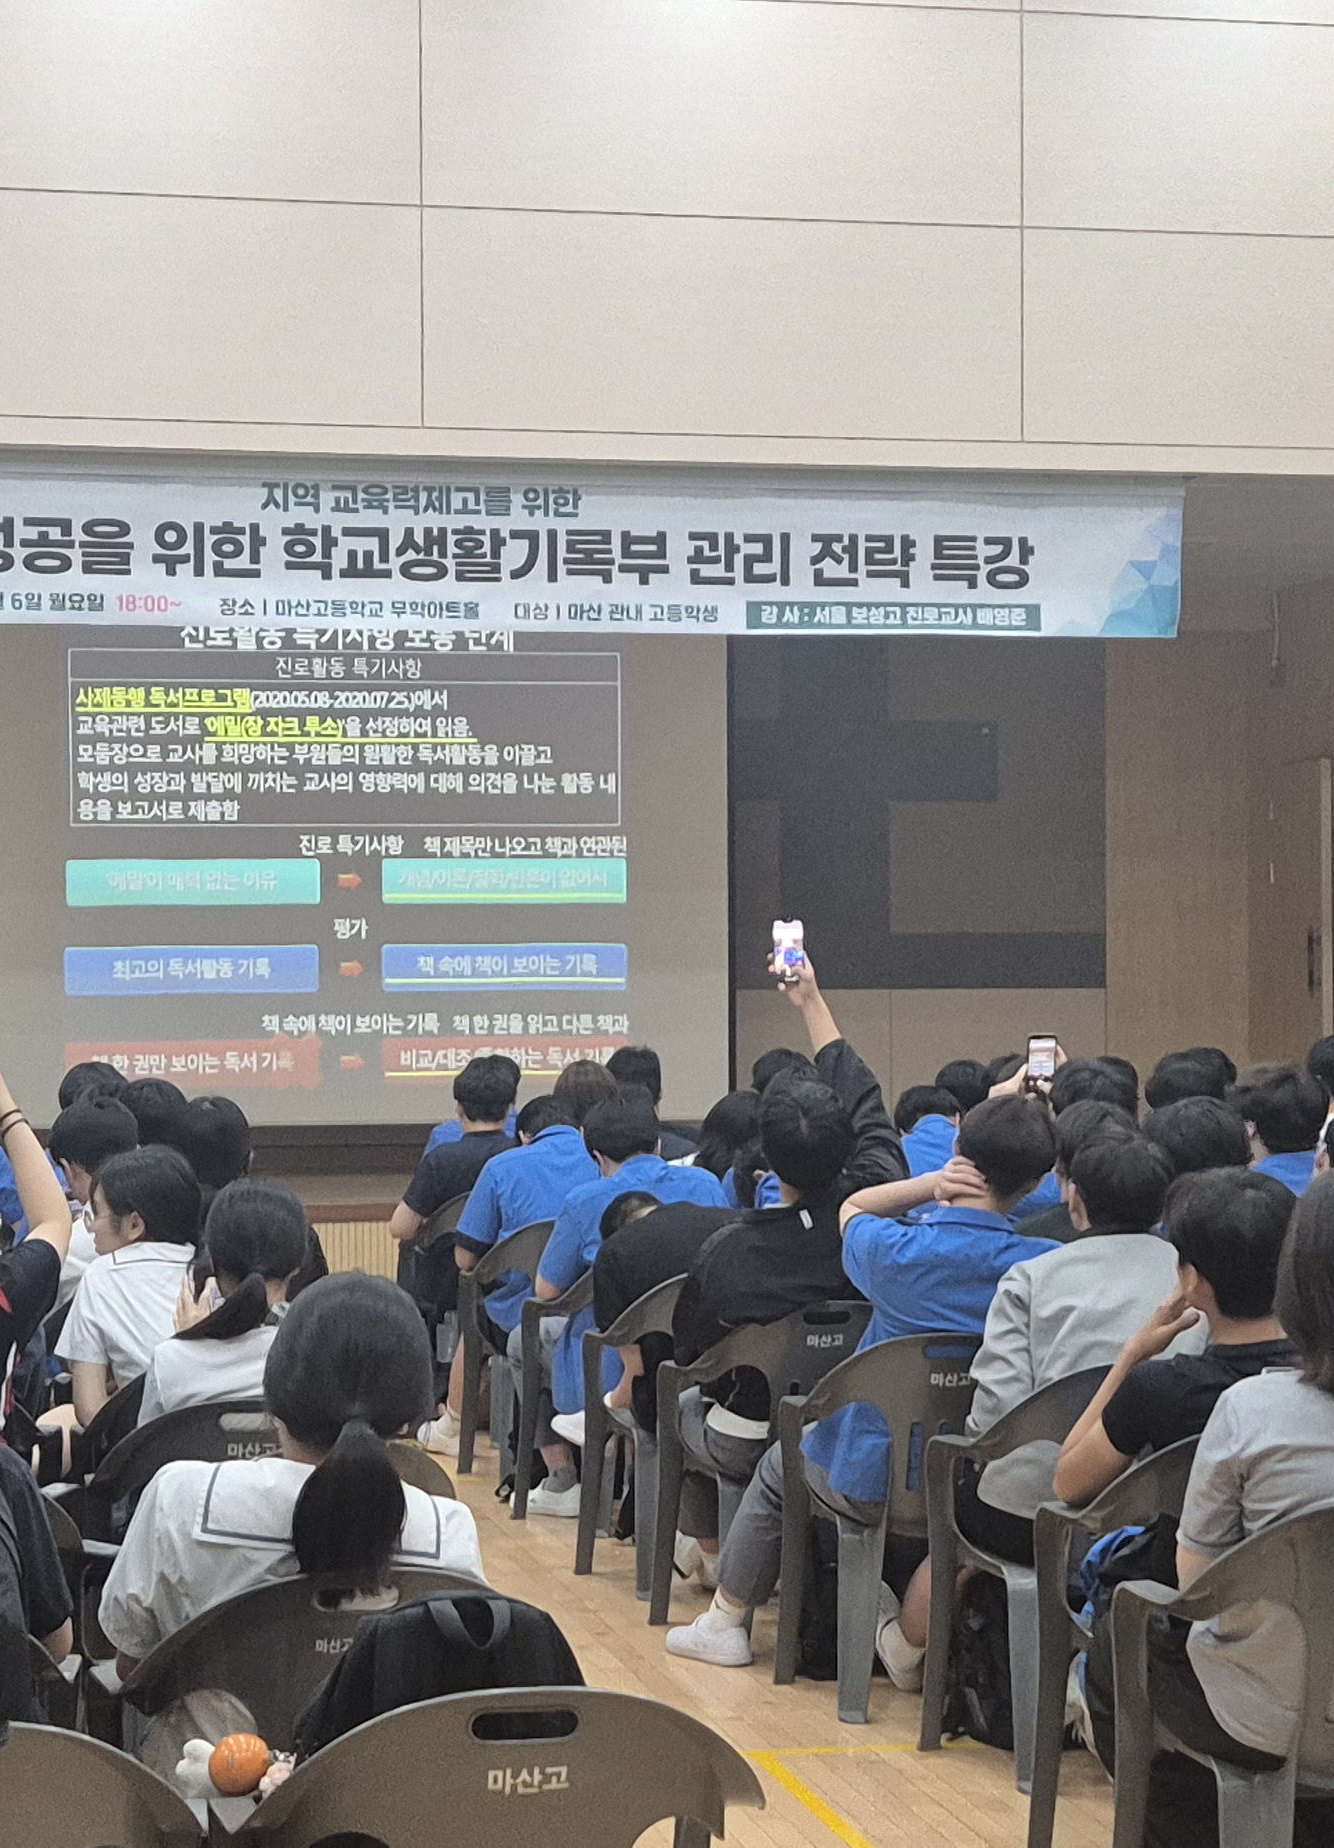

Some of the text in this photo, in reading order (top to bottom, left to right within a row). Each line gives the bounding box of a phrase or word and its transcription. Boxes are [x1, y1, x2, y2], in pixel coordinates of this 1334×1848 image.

[261, 482, 582, 518] 지역 교육력제고를 위한
[152, 520, 267, 578] 위한
[281, 522, 670, 586] 학교생활기록부
[687, 530, 791, 587] 관리
[809, 532, 917, 588] 전략
[930, 534, 1035, 590] 특강
[11, 592, 43, 611] 6일
[48, 592, 105, 612] 월요일
[219, 598, 256, 617] 장소
[275, 599, 384, 618] 마산고등학교
[391, 600, 480, 620] 무학아트홀
[514, 602, 549, 621] 대상
[568, 603, 603, 622] 마산
[608, 603, 643, 622] 관내
[649, 604, 719, 623] 고등학생
[761, 605, 778, 624] 강
[814, 606, 846, 625] 서울
[852, 606, 902, 625] 보성고
[906, 606, 973, 627] 진로교사
[275, 656, 422, 680] 진로활동 특기사항
[76, 686, 145, 708] 사제동행
[76, 715, 145, 737] 교육관련
[149, 715, 201, 736] 도서로
[266, 716, 301, 737] 자크
[366, 716, 432, 738] 선정하여
[435, 716, 473, 738] 읽음.
[77, 743, 553, 767] 모둠장으로 교사를 희망하는 부원들의 원활한 독서활동을 이끌고
[77, 771, 616, 794] 학생의 성장과 발달에 끼치는 교사의 영향력에 대해 의견을 나눈 활동 내
[77, 799, 240, 821] 용을 보고서로 제출함
[299, 834, 404, 856] 진로 특기사항
[423, 836, 627, 858] 책 제목만 나오고 책과 연관된
[243, 870, 277, 890] 이유
[334, 918, 368, 940] 평가
[112, 958, 271, 981] 최고의 독서활동 기록
[417, 954, 598, 977] 책 속에 책이 보이는 기록
[261, 1013, 440, 1035] 책 속에 책이 보이는 기록
[452, 1013, 629, 1035] 책 한 권을 읽고 다른 책과
[133, 1054, 167, 1075] 권만
[170, 1053, 221, 1075] 보이는
[224, 1051, 257, 1072] 독서
[547, 1047, 580, 1069] 독서
[806, 1334, 844, 1348] 마산고
[487, 1765, 569, 1797] 마산고
